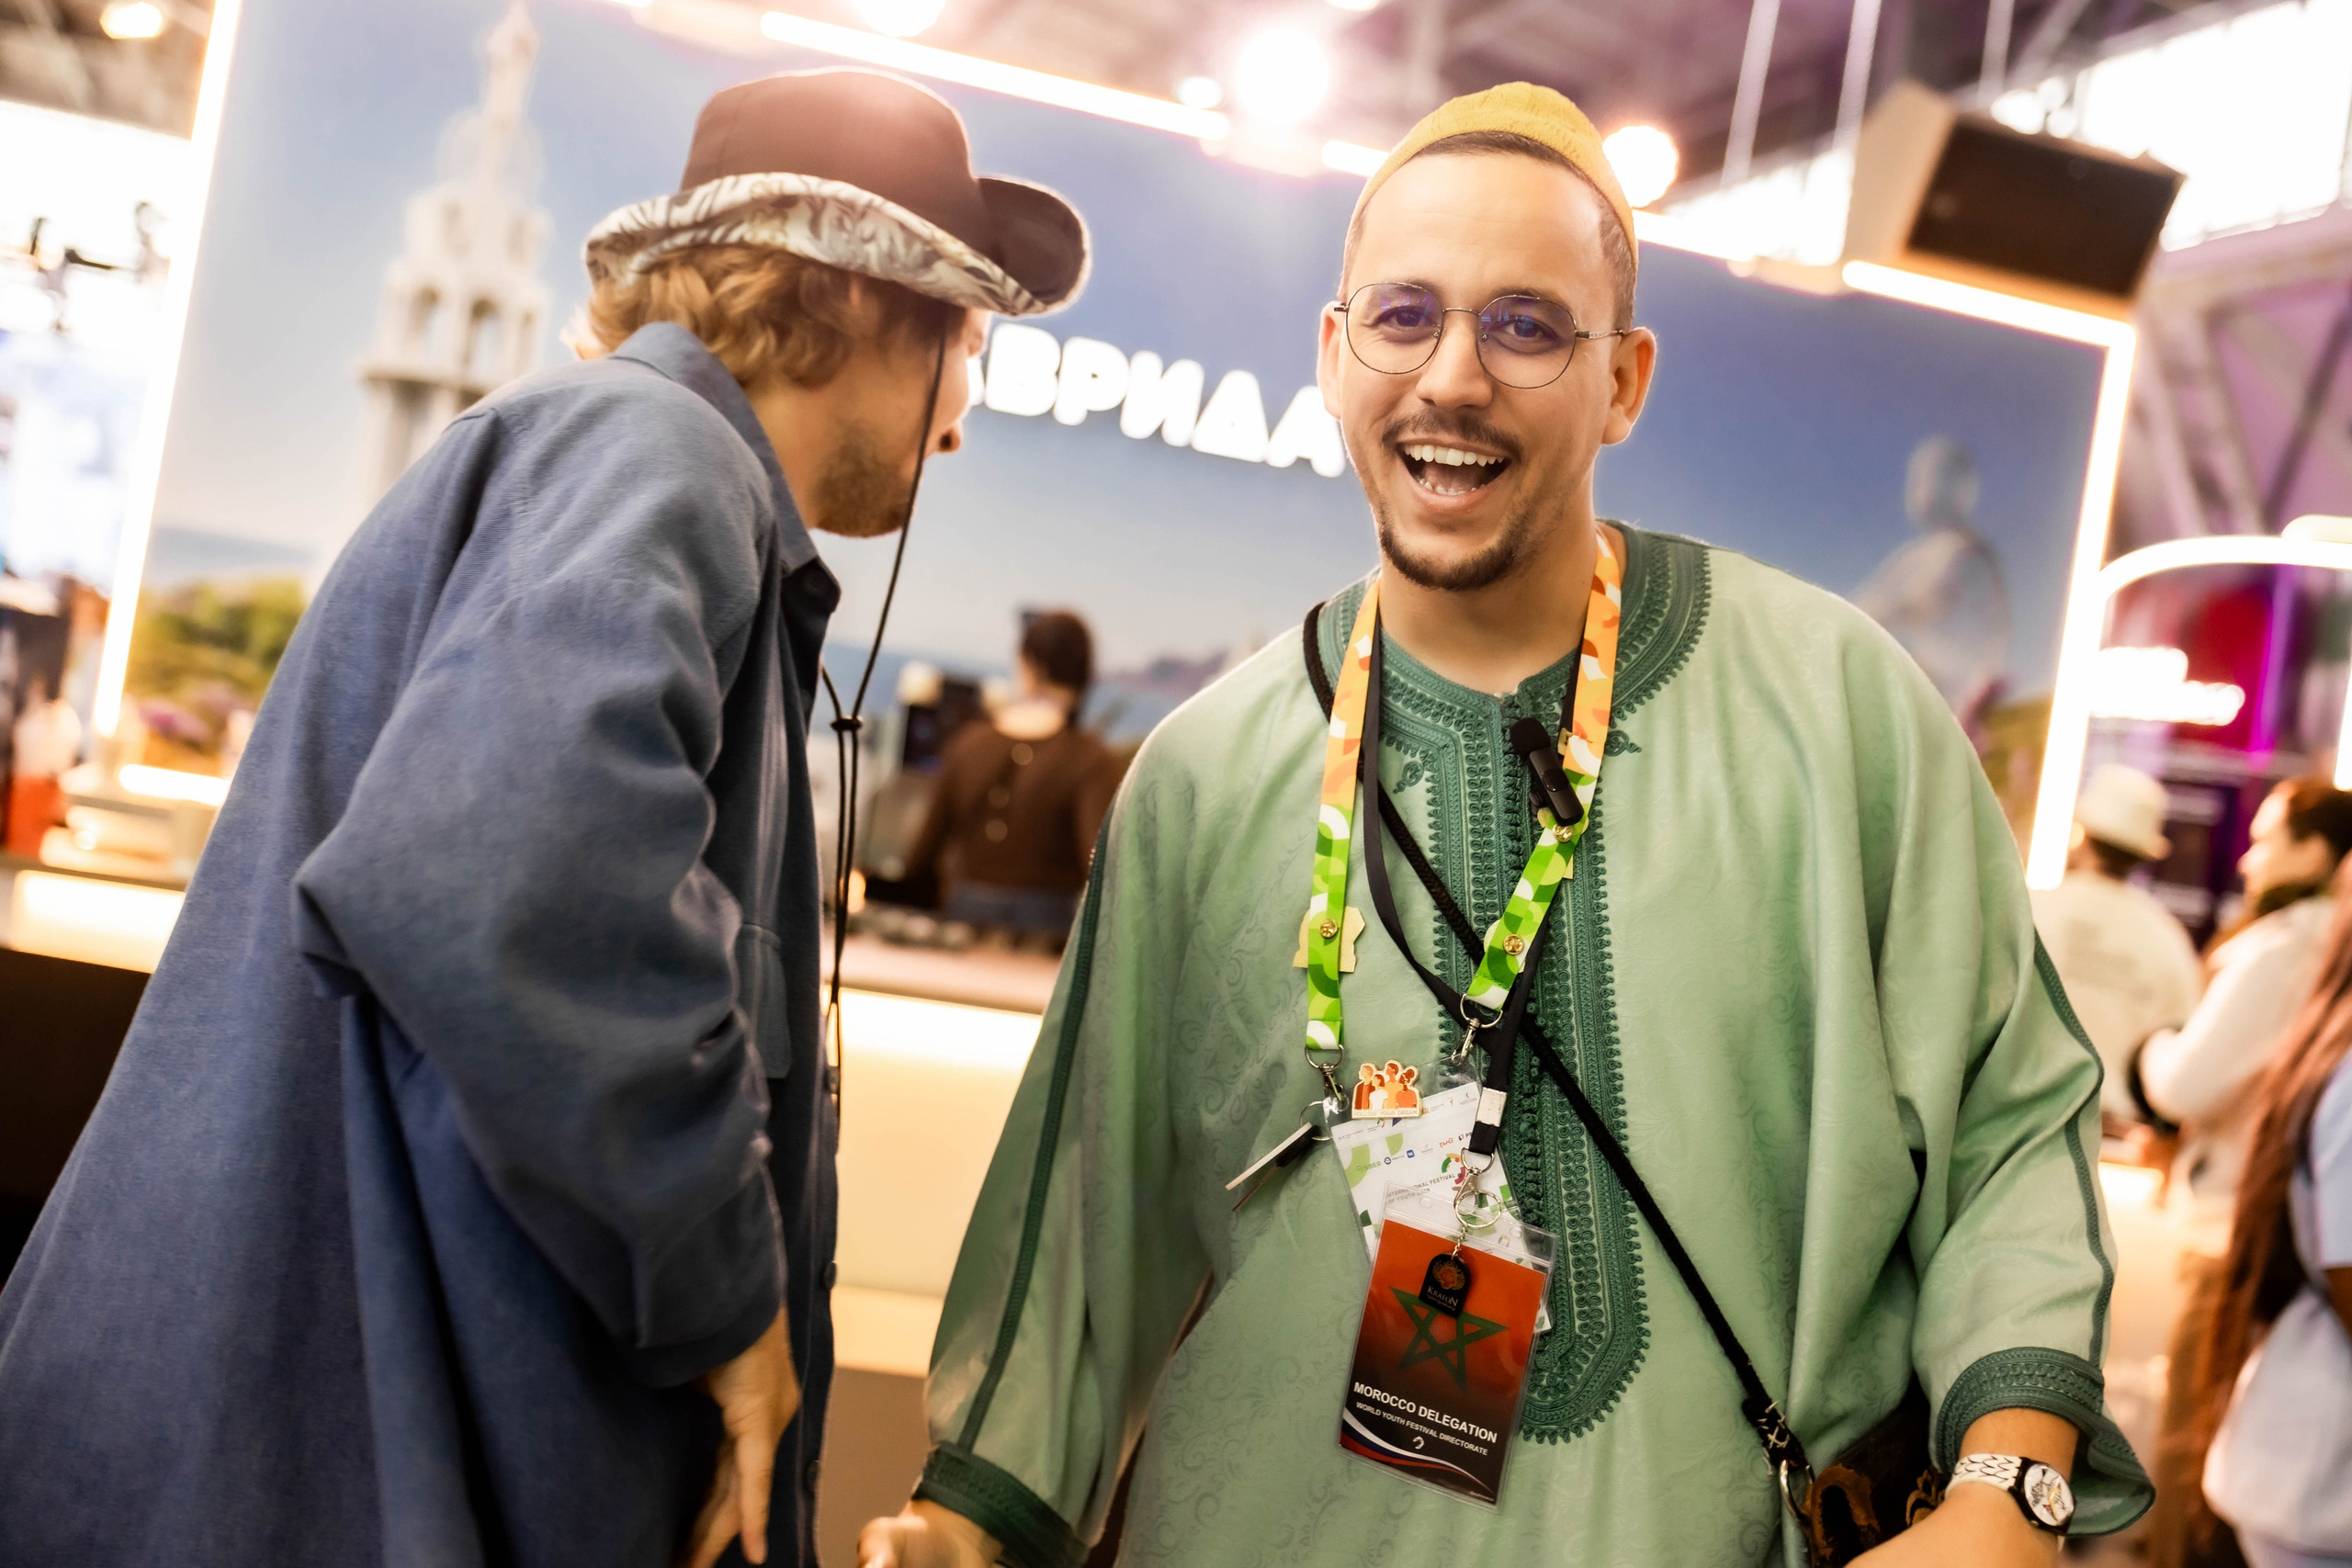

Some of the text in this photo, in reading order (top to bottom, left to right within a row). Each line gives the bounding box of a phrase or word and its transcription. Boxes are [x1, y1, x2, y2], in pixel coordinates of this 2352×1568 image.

[968, 322, 1346, 478] ВРИДА
[1396, 1193, 1413, 1202] YOUTH
[1430, 1174, 1455, 1185] FESTIVAL
[1353, 1382, 1498, 1443] MOROCCO DELEGATION
[1356, 1401, 1488, 1456] WORLD YOUTH FESTIVAL DIRECTORATE
